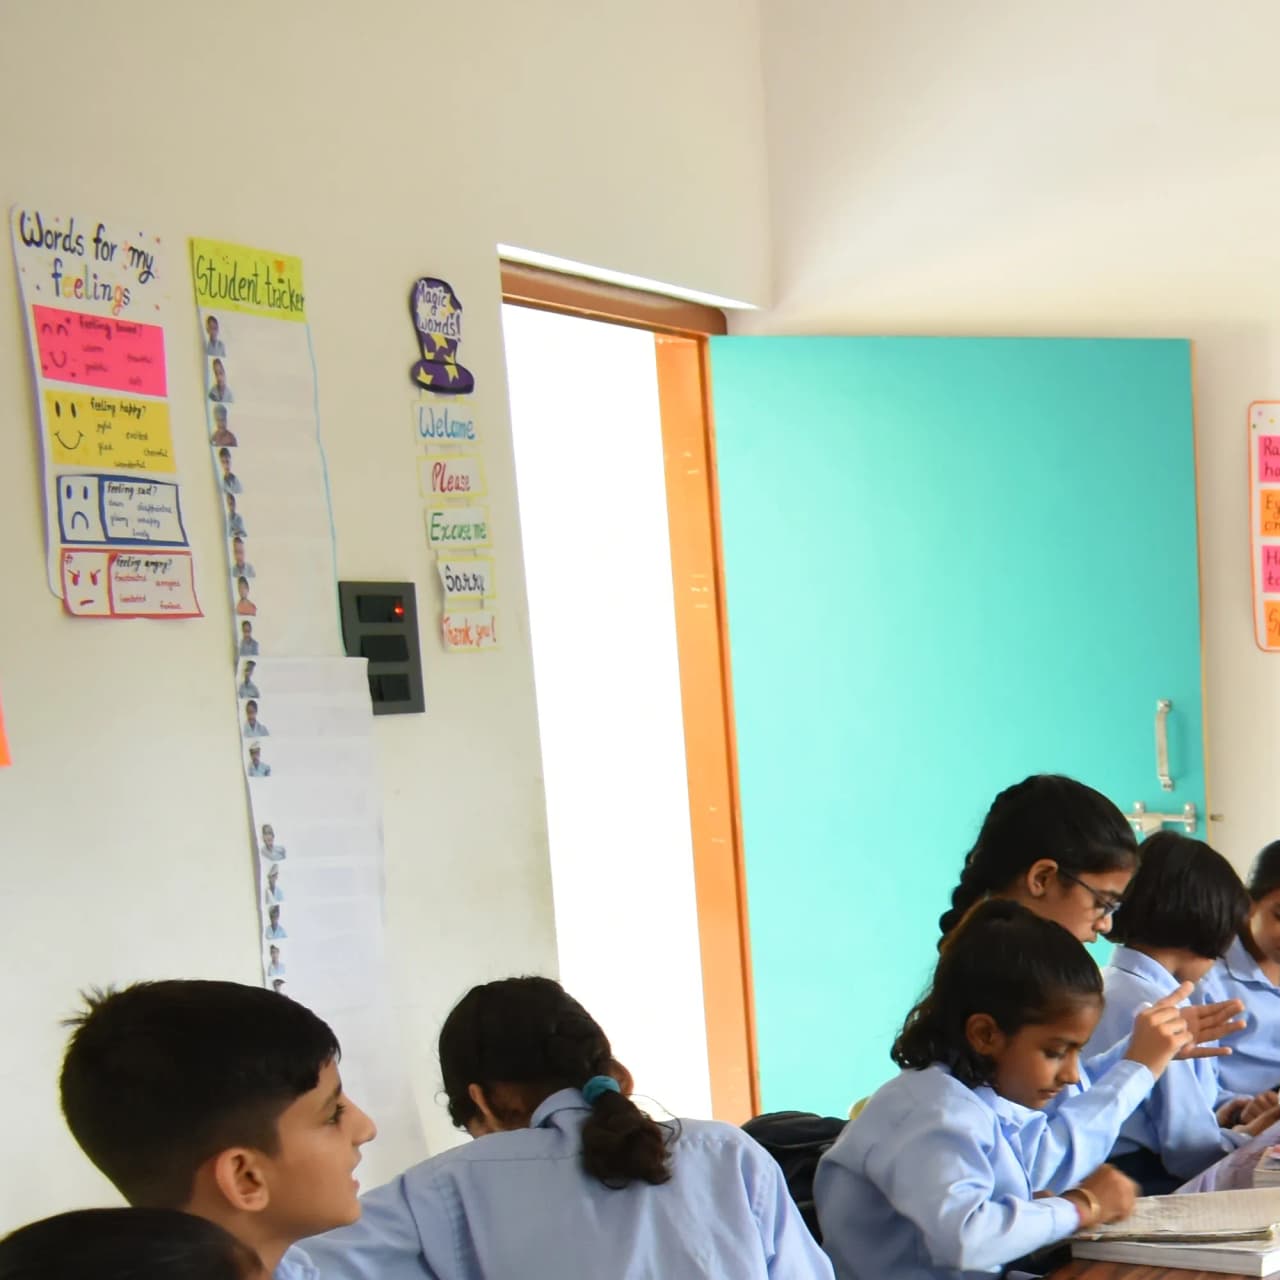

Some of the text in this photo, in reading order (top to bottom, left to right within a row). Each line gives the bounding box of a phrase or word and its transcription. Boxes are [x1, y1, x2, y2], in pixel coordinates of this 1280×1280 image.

[20, 211, 155, 284] Words for my
[51, 259, 131, 316] feelings
[196, 255, 304, 312] Student tracker
[417, 282, 447, 316] Magic
[419, 312, 462, 343] words!
[91, 397, 147, 420] feeling happy?
[417, 406, 475, 441] Welcome
[107, 481, 158, 501] feeling sad?
[431, 462, 471, 493] Please
[430, 512, 487, 541] Excuse me
[116, 555, 173, 574] feeling angry?
[446, 563, 485, 596] Sorry
[441, 615, 497, 647] Thank you!
